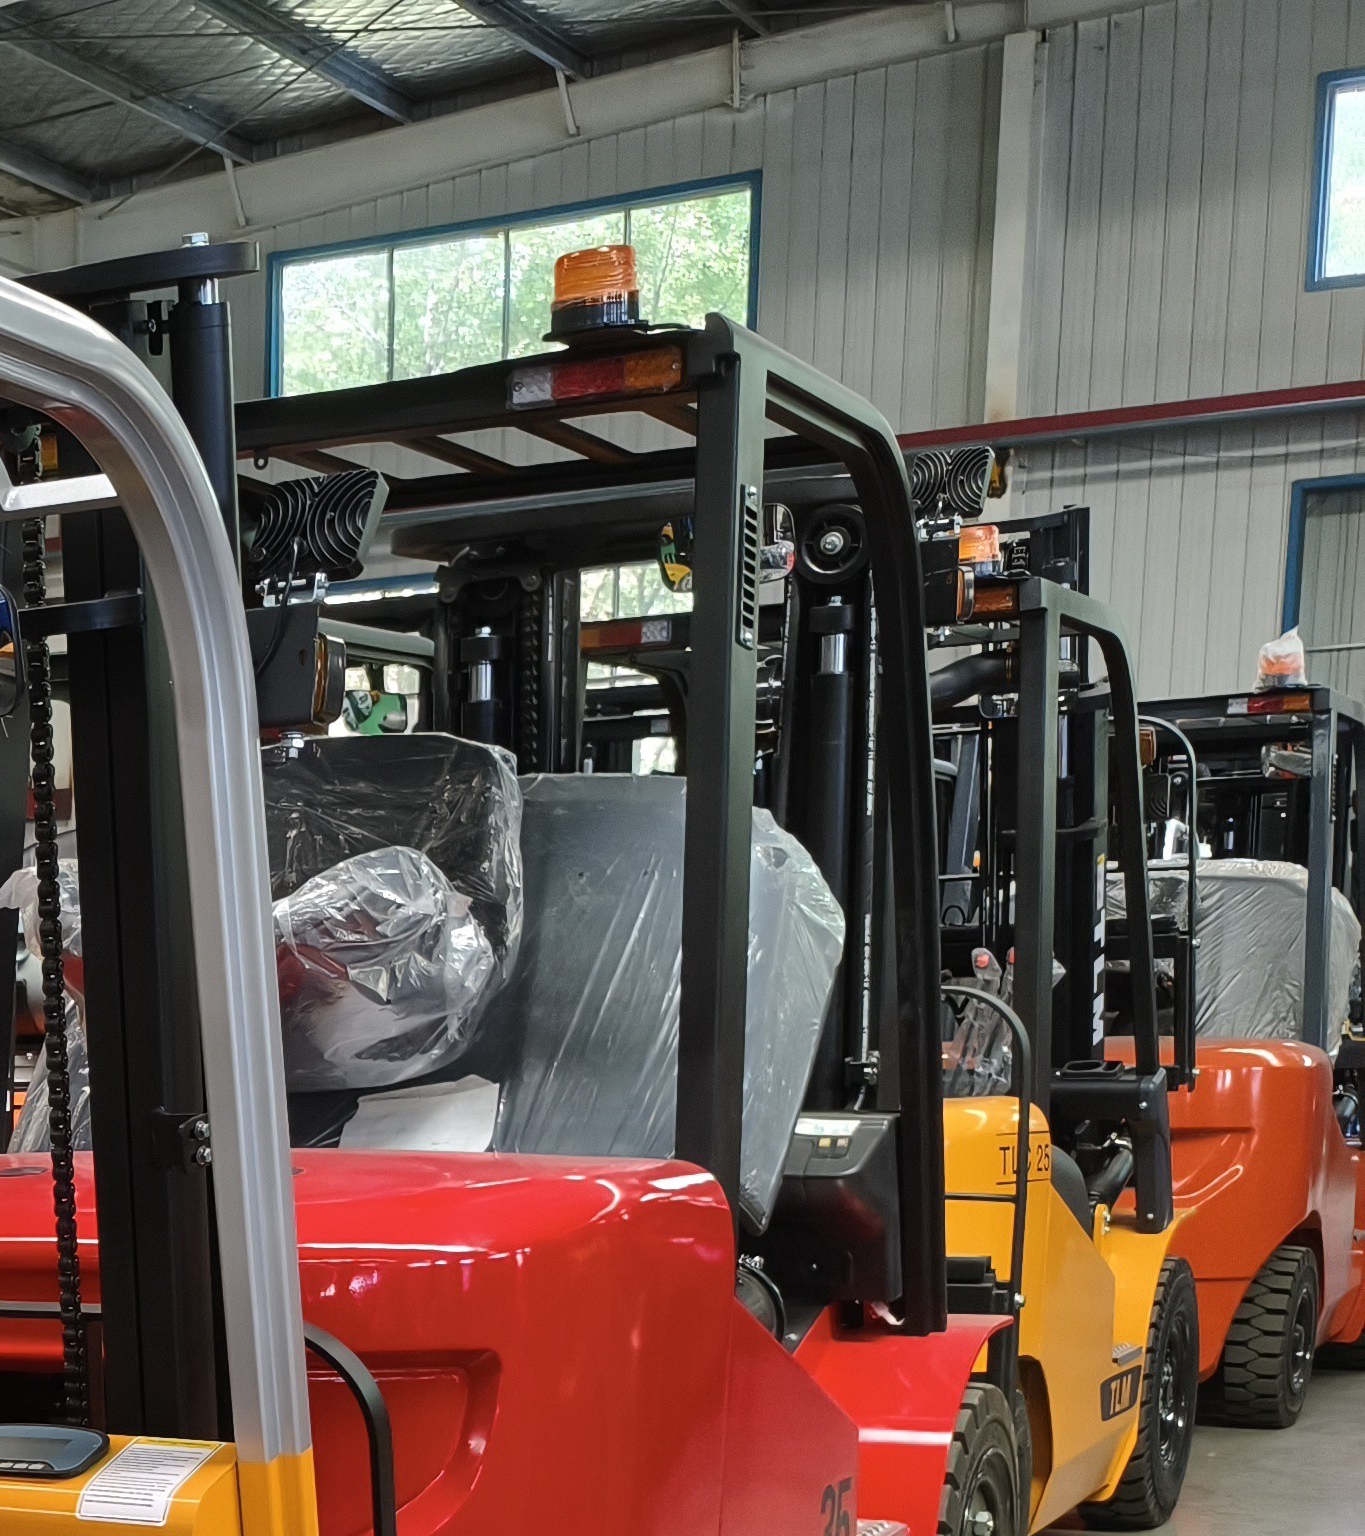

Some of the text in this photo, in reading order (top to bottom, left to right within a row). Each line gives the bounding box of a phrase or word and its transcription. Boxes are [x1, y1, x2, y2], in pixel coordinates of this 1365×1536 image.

[1093, 908, 1105, 1046] TLM
[999, 1144, 1050, 1175] TL 25
[1110, 1374, 1132, 1415] TLM
